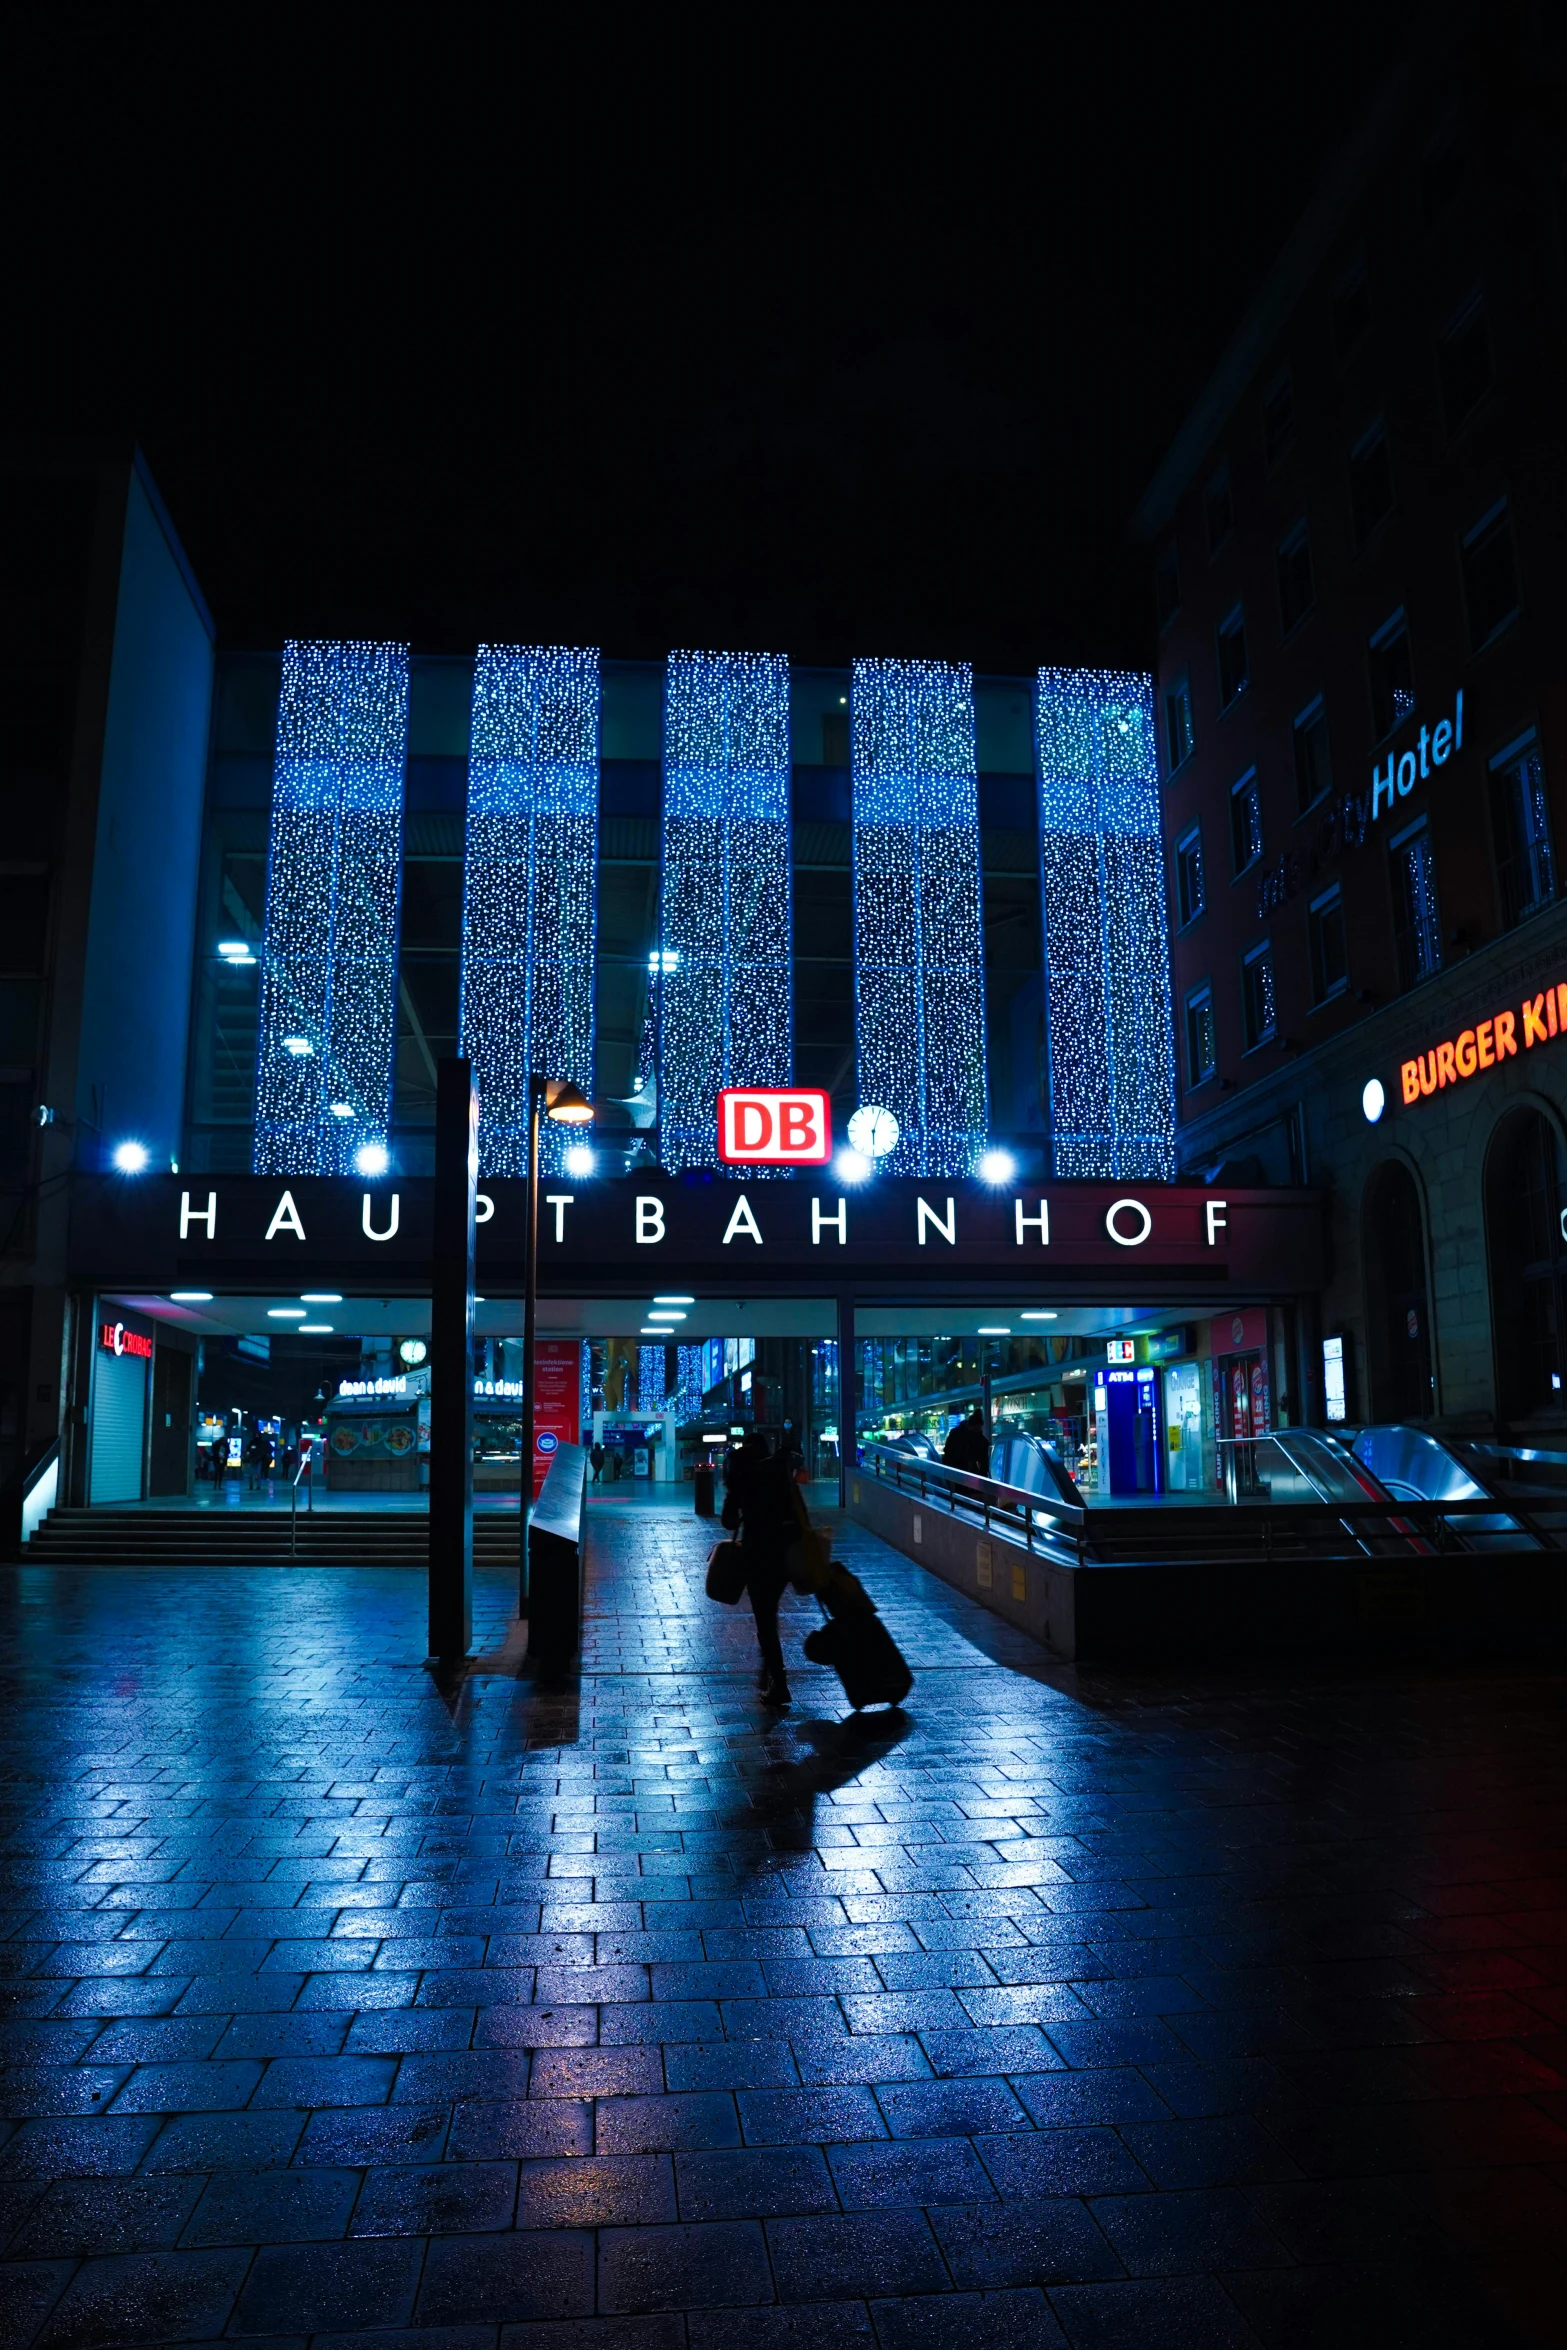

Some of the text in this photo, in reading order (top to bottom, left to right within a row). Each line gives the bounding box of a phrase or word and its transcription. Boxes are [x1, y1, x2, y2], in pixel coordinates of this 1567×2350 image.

[1401, 1009, 1518, 1105] BURGER
[733, 1101, 818, 1152] DB
[177, 1189, 1228, 1247] HAUPTBAHNHOF
[123, 1330, 152, 1358] CROBAG
[1108, 1371, 1134, 1382] ATM
[1213, 1391, 1222, 1425] KING
